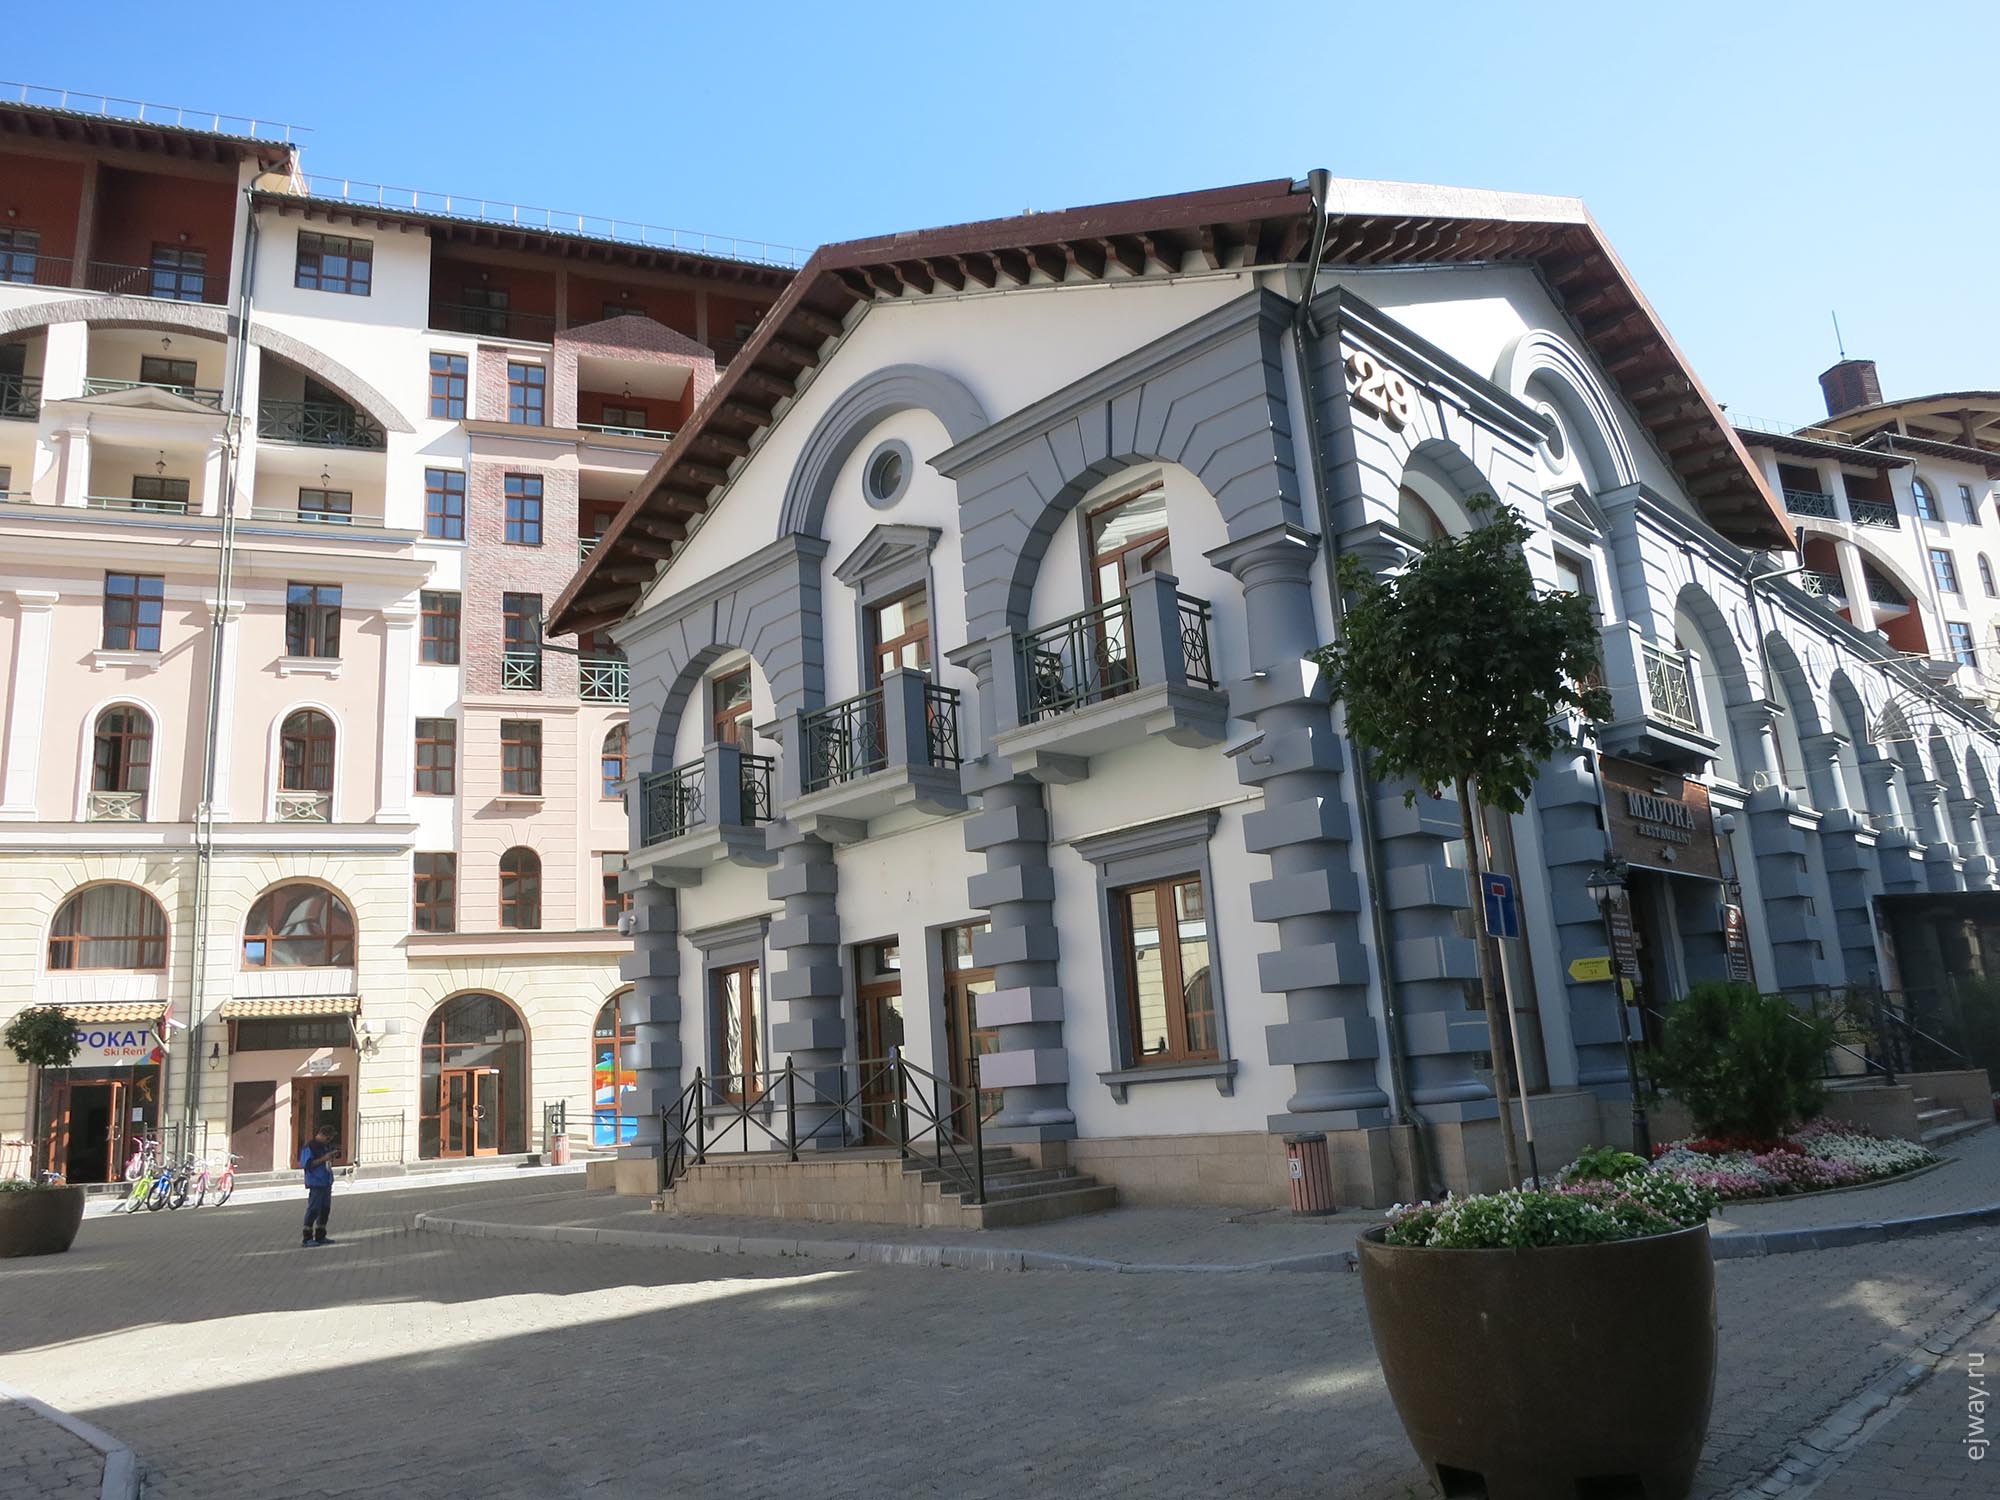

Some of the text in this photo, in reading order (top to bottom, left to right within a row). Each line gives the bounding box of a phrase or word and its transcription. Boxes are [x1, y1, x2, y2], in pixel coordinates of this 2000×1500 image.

[1349, 350, 1417, 428] 29
[1628, 791, 1697, 830] MEDORA
[1638, 823, 1692, 846] RESTAURANT
[70, 1030, 150, 1049] РОКАТ
[103, 1047, 146, 1057] Ski Rent
